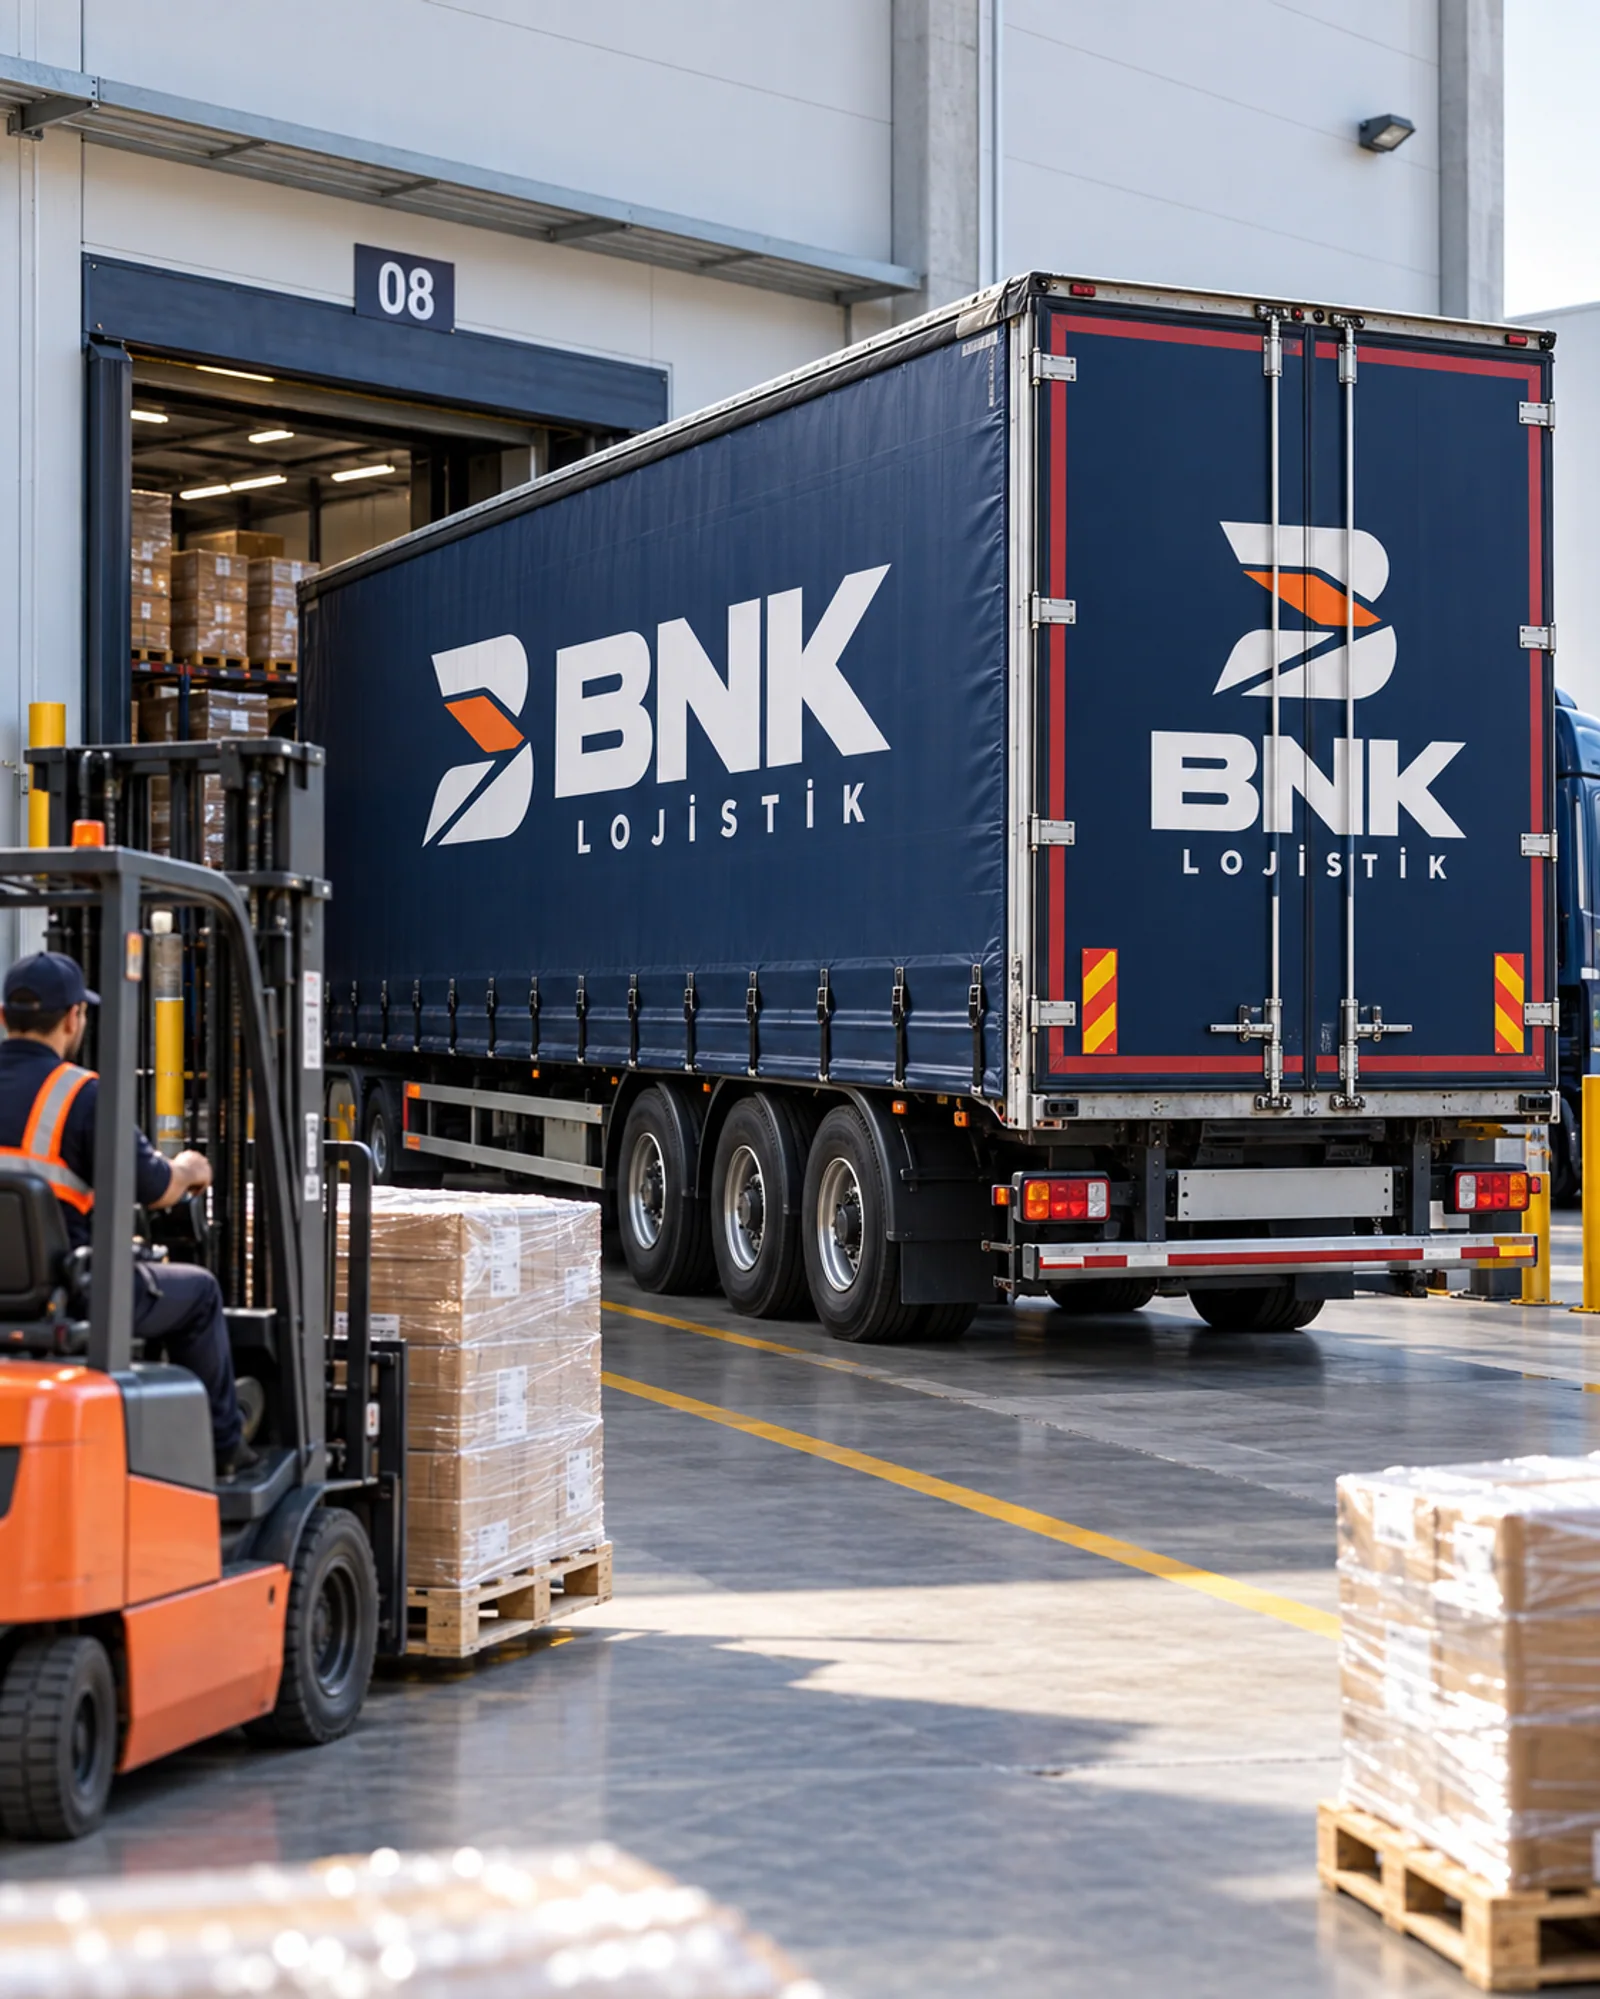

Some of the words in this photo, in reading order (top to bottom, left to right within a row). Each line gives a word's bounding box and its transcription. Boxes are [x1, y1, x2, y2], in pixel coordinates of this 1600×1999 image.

[378, 261, 435, 321] 08
[554, 563, 892, 799] BNK
[577, 778, 866, 855] LOJİSTİK
[1151, 730, 1467, 838] BNK
